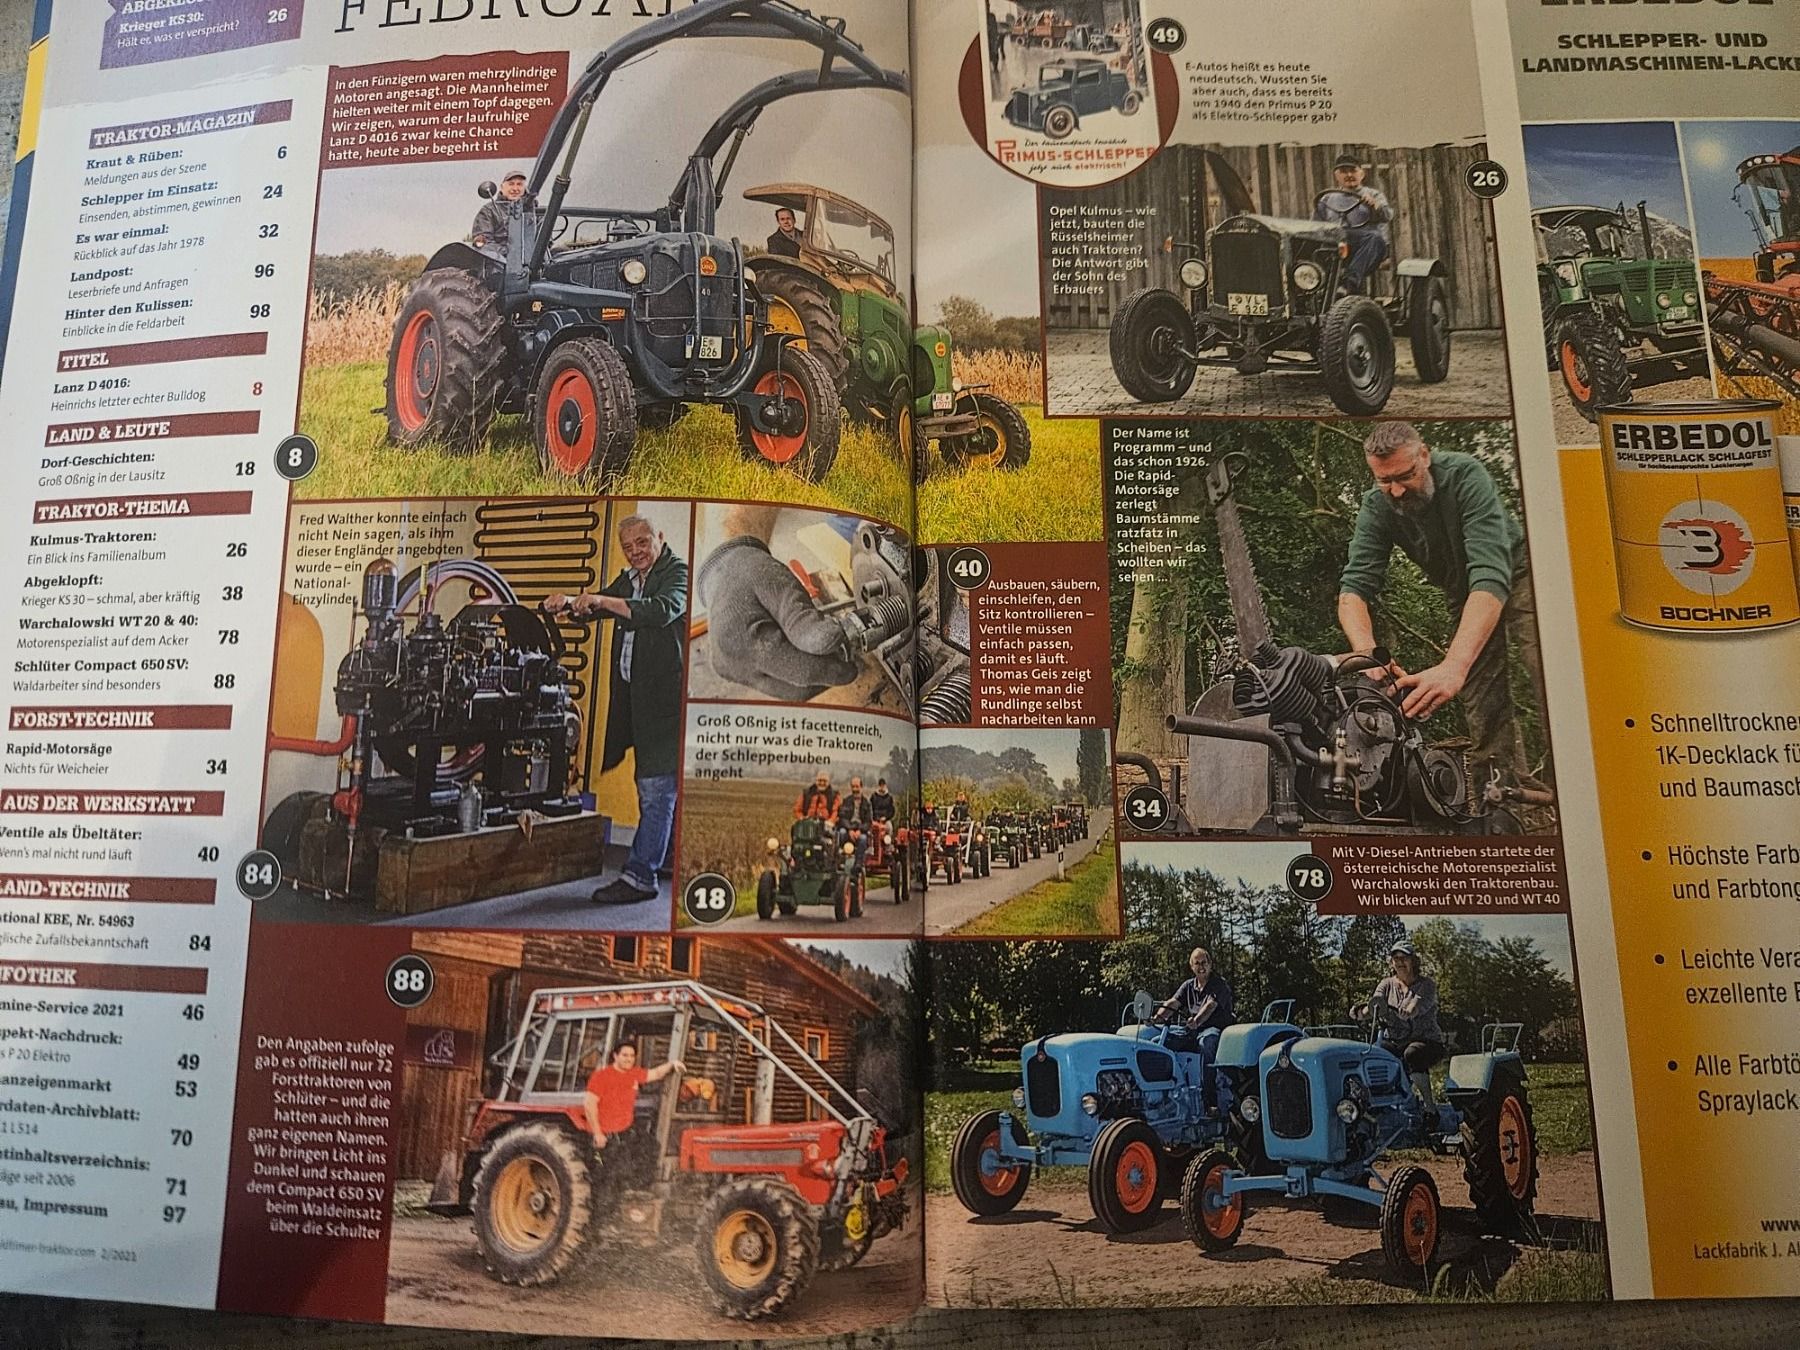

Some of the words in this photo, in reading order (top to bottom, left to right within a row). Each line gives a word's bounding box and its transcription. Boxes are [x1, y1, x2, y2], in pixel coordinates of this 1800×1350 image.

[268, 9, 287, 23] 26
[1153, 27, 1179, 43] 49
[1558, 33, 1707, 49] SCHLEPPER-
[1715, 33, 1768, 48] UND
[335, 80, 346, 90] In
[349, 79, 369, 89] den
[372, 75, 427, 87] Fünzigern
[430, 71, 465, 82] waren
[469, 67, 557, 80] mehrzylindrige
[1190, 75, 1257, 85] neudeutsch.
[1260, 75, 1307, 85] Wussten
[1311, 75, 1327, 84] Sie
[334, 91, 383, 104] Motoren
[386, 87, 443, 101] angesagt.
[447, 85, 466, 96] Die
[470, 81, 548, 94] Mannheimer
[333, 105, 370, 118] hielten
[373, 103, 408, 115] weiter
[411, 101, 431, 112] mit
[434, 99, 469, 110] einem
[472, 97, 497, 110] Topf
[499, 96, 553, 109] dagegen.
[94, 110, 256, 146] TRAKTOR-MAGAZIN
[86, 156, 122, 170] Kraut
[126, 155, 135, 165] &
[139, 149, 183, 163] Rüben:
[278, 146, 287, 160] 6
[1473, 171, 1500, 187] 26
[81, 190, 144, 208] Schlepper
[148, 187, 164, 199] im
[167, 181, 218, 196] Einsatz:
[263, 185, 283, 200] 24
[79, 209, 131, 224] Einsenden,
[133, 202, 189, 217] abstimmen,
[192, 194, 241, 212] gewinnen
[75, 233, 90, 245] Es
[94, 231, 119, 243] war
[122, 225, 169, 240] einmal:
[259, 224, 279, 238] 32
[1051, 232, 1134, 242] Rüsselsheimer
[1052, 245, 1079, 255] auch
[1082, 245, 1143, 255] Traktoren?
[254, 264, 274, 278] 96
[1052, 258, 1072, 268] Die
[1074, 258, 1122, 268] Antwort
[1125, 258, 1148, 270] gibt
[70, 266, 133, 283] Landpost:
[1053, 284, 1104, 295] Erbauers
[65, 305, 105, 320] Hinter
[109, 304, 132, 316] den
[135, 298, 193, 314] Kulissen:
[250, 305, 270, 319] 98
[62, 352, 109, 369] TITEL
[253, 382, 263, 396] 8
[51, 398, 96, 412] Heinrichs
[99, 396, 130, 409] letzter
[133, 393, 164, 405] echter
[167, 389, 206, 404] Bulldog
[49, 427, 94, 444] LAND
[99, 427, 111, 439] &
[115, 421, 170, 438] LEUTE
[1113, 428, 1133, 438] Der
[1137, 428, 1172, 438] Name
[1176, 428, 1189, 438] ist
[1612, 421, 1771, 450] ERBEDOL
[41, 452, 155, 469] Dorf-Geschichten:
[288, 448, 302, 467] 8
[1114, 457, 1134, 466] das
[1138, 456, 1172, 466] schon
[1176, 456, 1209, 467] 1926.
[1617, 452, 1704, 462] SCHLEPPERLACK
[1708, 450, 1771, 461] SCHLAGFEST
[235, 462, 255, 476] 18
[1115, 484, 1180, 497] Motorsäge
[38, 499, 190, 520] TRAKTOR-THEMA
[1116, 499, 1157, 511] zerlegt
[300, 515, 324, 525] Fred
[328, 514, 373, 524] Walther
[377, 513, 418, 524] konnte
[422, 511, 466, 523] einfach
[1116, 514, 1200, 524] Baumstämme
[30, 532, 157, 546] Kulmus-Traktoren:
[27, 554, 42, 565] Ein
[45, 552, 67, 564] Blick
[70, 553, 84, 563] ins
[87, 550, 166, 562] Familienalbum
[226, 543, 247, 557] 26
[955, 560, 982, 576] 40
[24, 574, 103, 589] Abgeklopft:
[988, 580, 1048, 591] Ausbauen,
[1051, 580, 1100, 591] säubern,
[222, 586, 243, 601] 38
[979, 594, 1055, 606] einschleifen,
[1059, 594, 1081, 604] den
[218, 630, 239, 644] 78
[980, 624, 1022, 635] Ventile
[1026, 624, 1072, 634] müssen
[214, 674, 235, 689] 88
[980, 669, 1028, 680] Thomas
[1032, 668, 1058, 679] Geis
[1062, 668, 1092, 681] zeigt
[13, 679, 78, 691] Waldarbeiter
[82, 678, 103, 690] sind
[106, 678, 161, 690] besonders
[13, 711, 154, 727] FORST-TECHNIK
[981, 714, 1062, 725] nacharbeiten
[1066, 714, 1096, 725] kann
[1651, 712, 1800, 733] Schnelltrockne
[6, 743, 112, 756] Rapid-Motorsäge
[697, 733, 730, 744] nicht
[736, 736, 758, 745] nur
[763, 737, 788, 746] was
[794, 736, 813, 747] die
[817, 737, 873, 752] Traktoren
[1656, 744, 1779, 765] 1K-Decklack
[206, 759, 227, 774] 34
[1660, 778, 1696, 798] und
[4, 795, 39, 810] AUS
[43, 796, 79, 811] DER
[84, 796, 195, 812] WERKSTATT
[1133, 800, 1161, 818] 34
[198, 847, 219, 862] 40
[1668, 845, 1749, 866] Höchste
[245, 864, 273, 885] 84
[1343, 862, 1439, 874] österreichische
[1443, 861, 1557, 876] Motorenspezialist
[1295, 869, 1324, 887] 78
[1351, 878, 1439, 890] Warchalowski
[1443, 878, 1467, 889] den
[1471, 877, 1559, 889] Traktorenbau.
[1673, 879, 1710, 899] und
[694, 887, 726, 909] 18
[189, 935, 211, 950] 84
[1681, 948, 1754, 970] Leichte
[394, 970, 425, 991] 88
[1686, 982, 1787, 1004] exzellente
[182, 1004, 204, 1021] 46
[258, 1036, 282, 1050] Den
[286, 1038, 342, 1053] Angaben
[346, 1040, 394, 1056] zufolge
[178, 1054, 200, 1070] 49
[1695, 1055, 1731, 1076] Alle
[176, 1081, 198, 1097] 53
[171, 1130, 192, 1146] 70
[166, 1178, 188, 1196] 71
[163, 1206, 186, 1223] 97
[1694, 1242, 1768, 1259] Lackfabrik
[1772, 1242, 1781, 1257] J.
